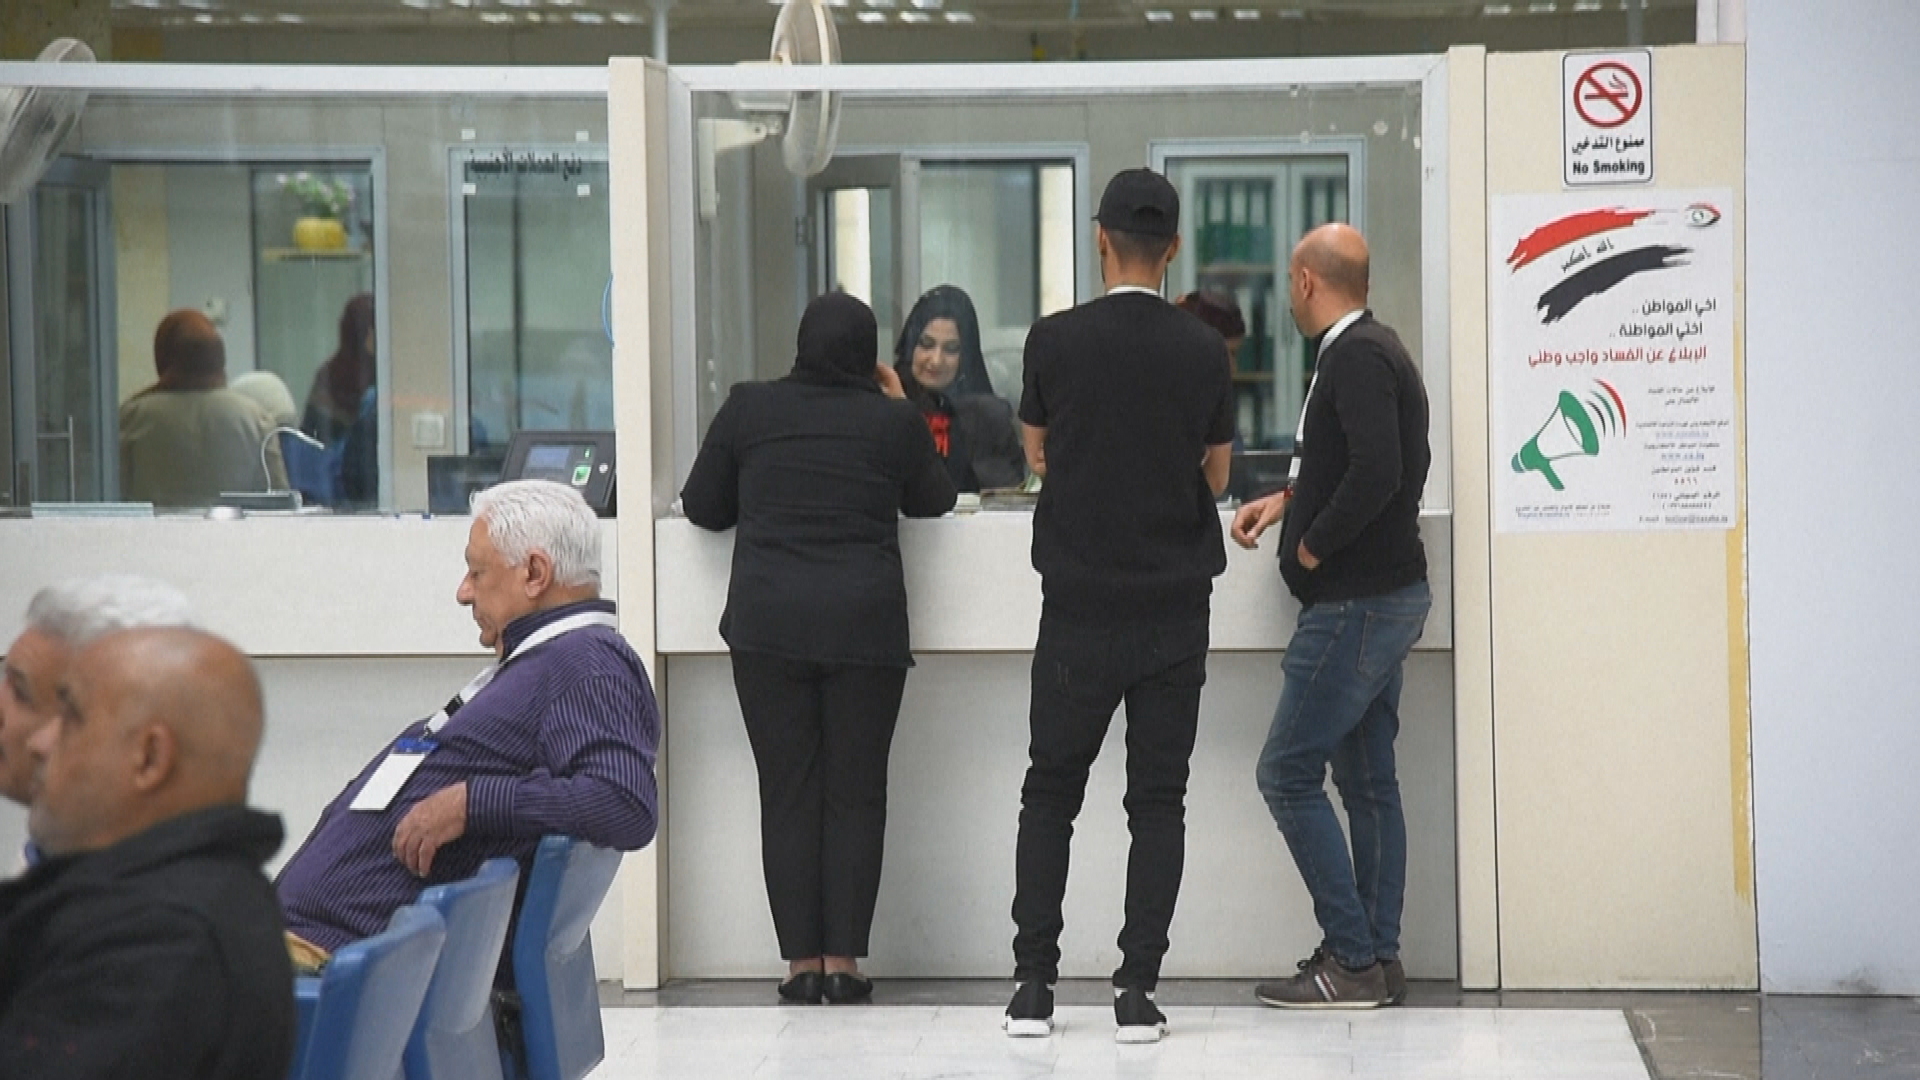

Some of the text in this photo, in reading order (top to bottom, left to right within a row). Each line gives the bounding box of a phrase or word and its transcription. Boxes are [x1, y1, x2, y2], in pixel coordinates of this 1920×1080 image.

[1572, 133, 1645, 155] ممنوع التدخين
[1573, 159, 1645, 175] No Smoking
[1619, 323, 1674, 339] المواطنة
[1528, 349, 1562, 369] وطني
[1566, 349, 1599, 367] واجب
[1602, 347, 1643, 364] الفساد
[1646, 347, 1664, 365] عن
